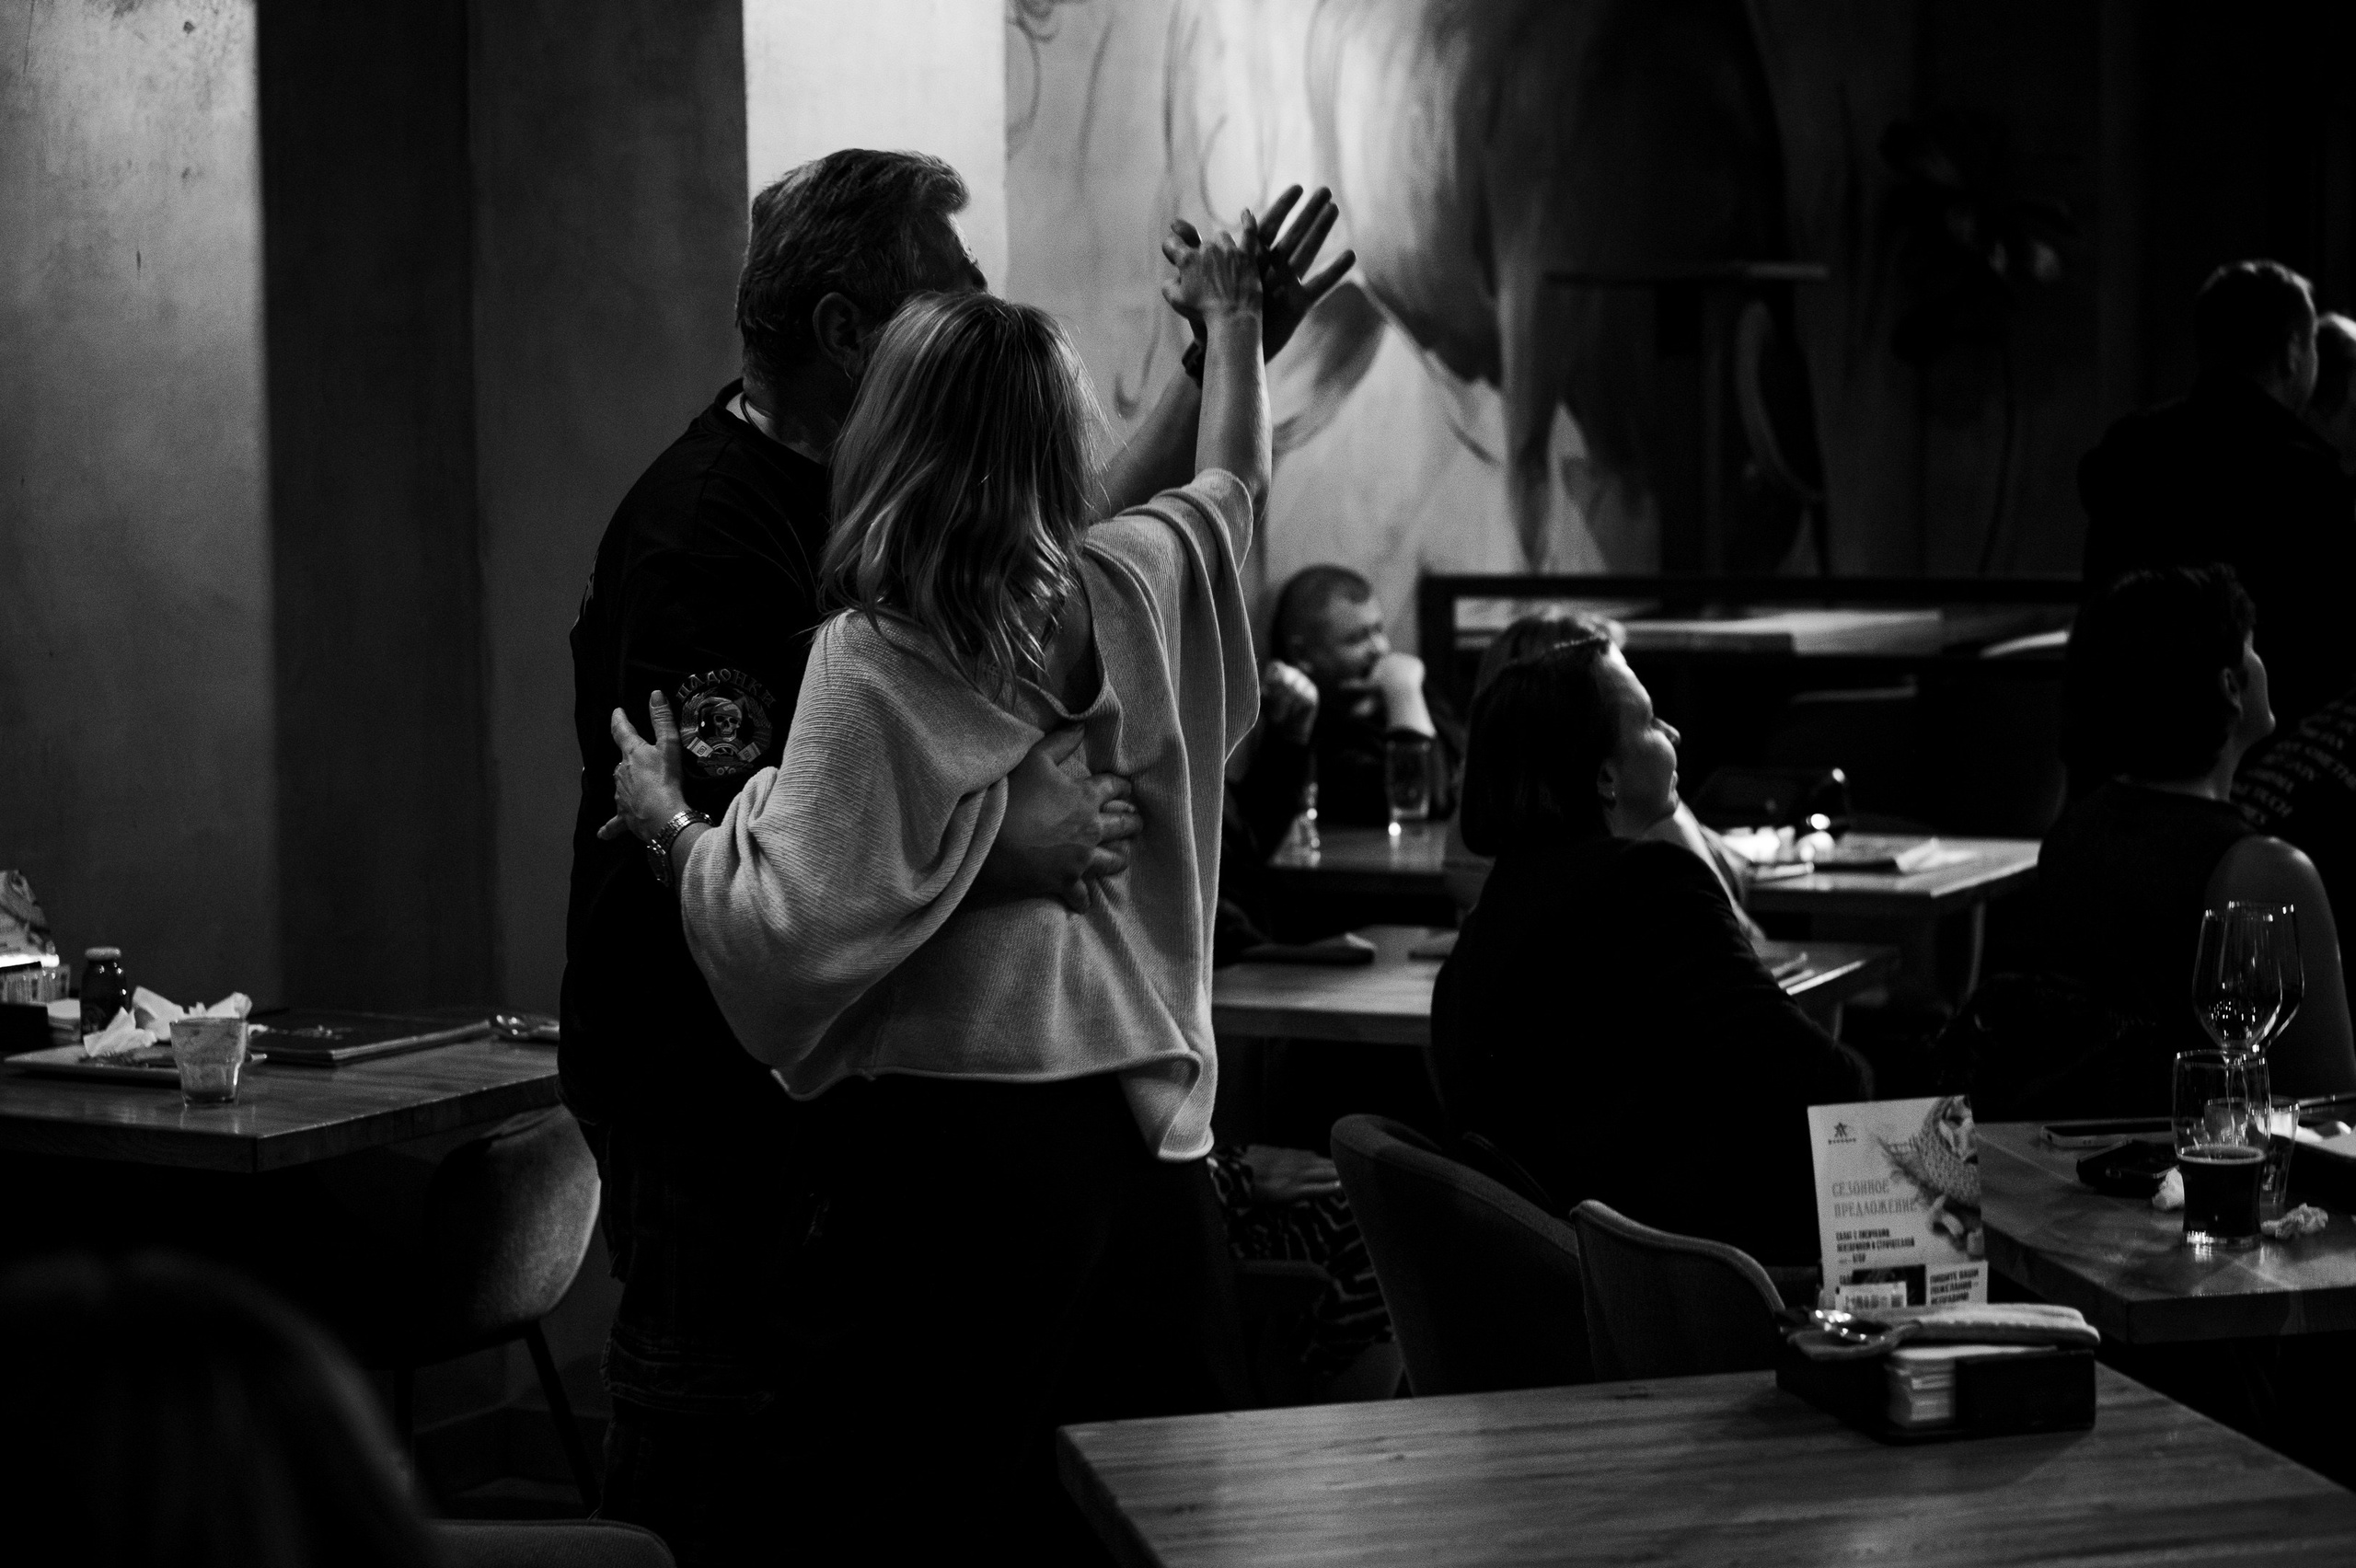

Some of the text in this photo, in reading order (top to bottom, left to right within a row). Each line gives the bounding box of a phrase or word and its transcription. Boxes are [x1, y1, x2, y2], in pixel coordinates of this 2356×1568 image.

[676, 668, 777, 709] ПАДОНКИ
[1831, 1179, 1889, 1197] СЕЗОННОЕ
[1834, 1197, 1916, 1217] ПРЕДЛОЖЕНИЕ
